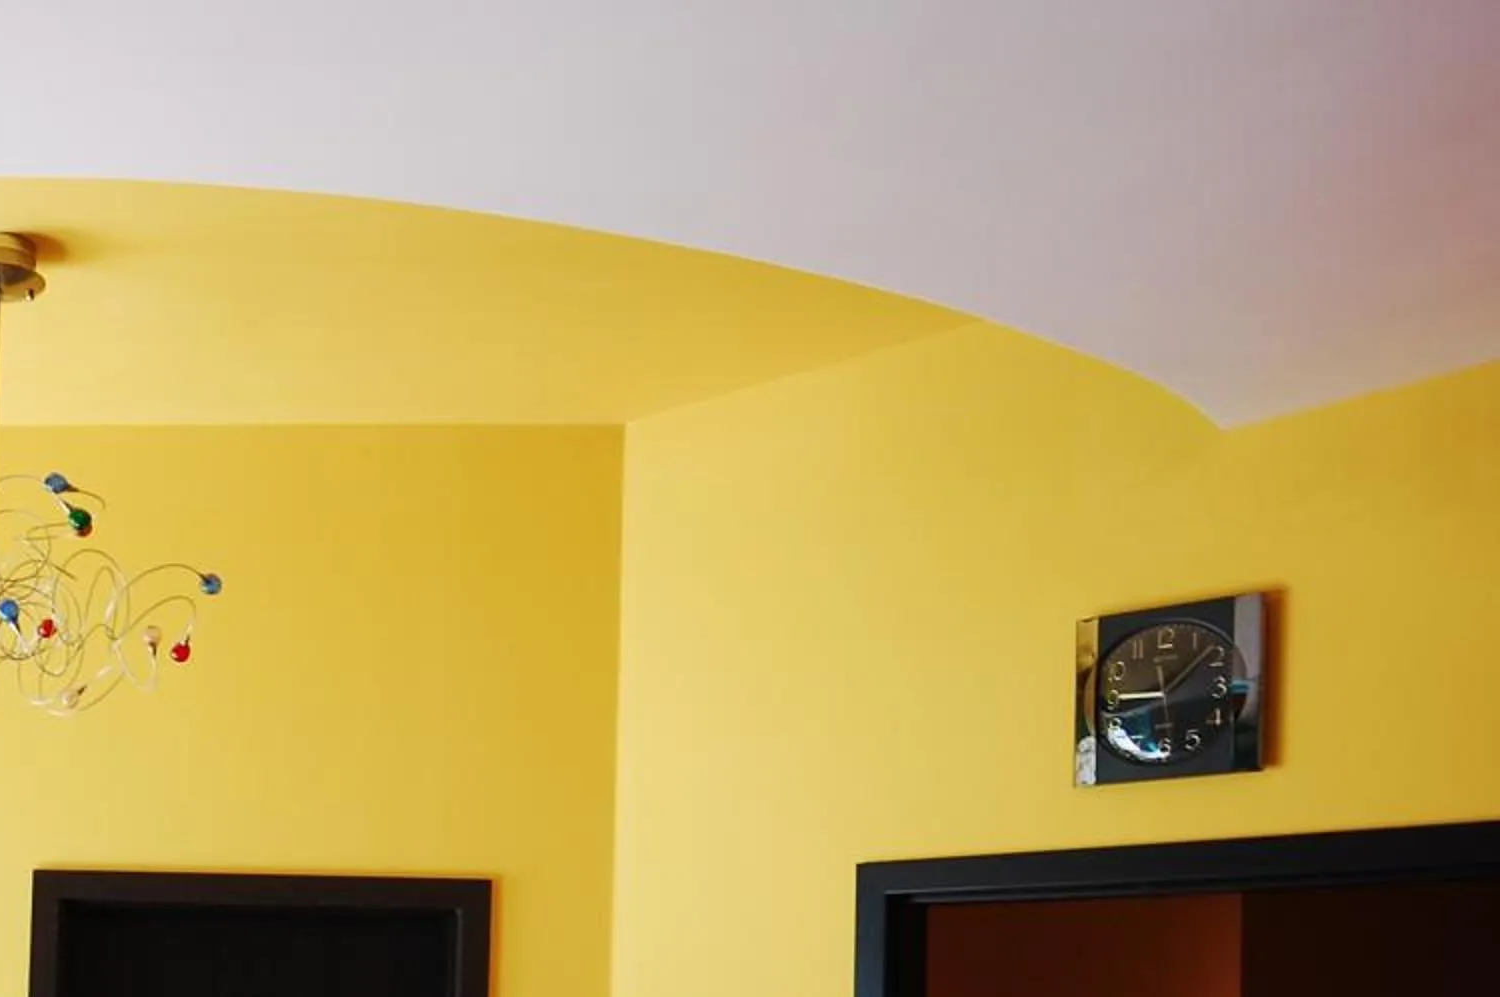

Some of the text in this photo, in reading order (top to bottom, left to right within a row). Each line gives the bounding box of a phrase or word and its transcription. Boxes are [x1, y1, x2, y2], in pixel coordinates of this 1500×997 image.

[1211, 676, 1228, 699] 3
[1205, 707, 1222, 726] 4
[1184, 728, 1202, 752] 5
